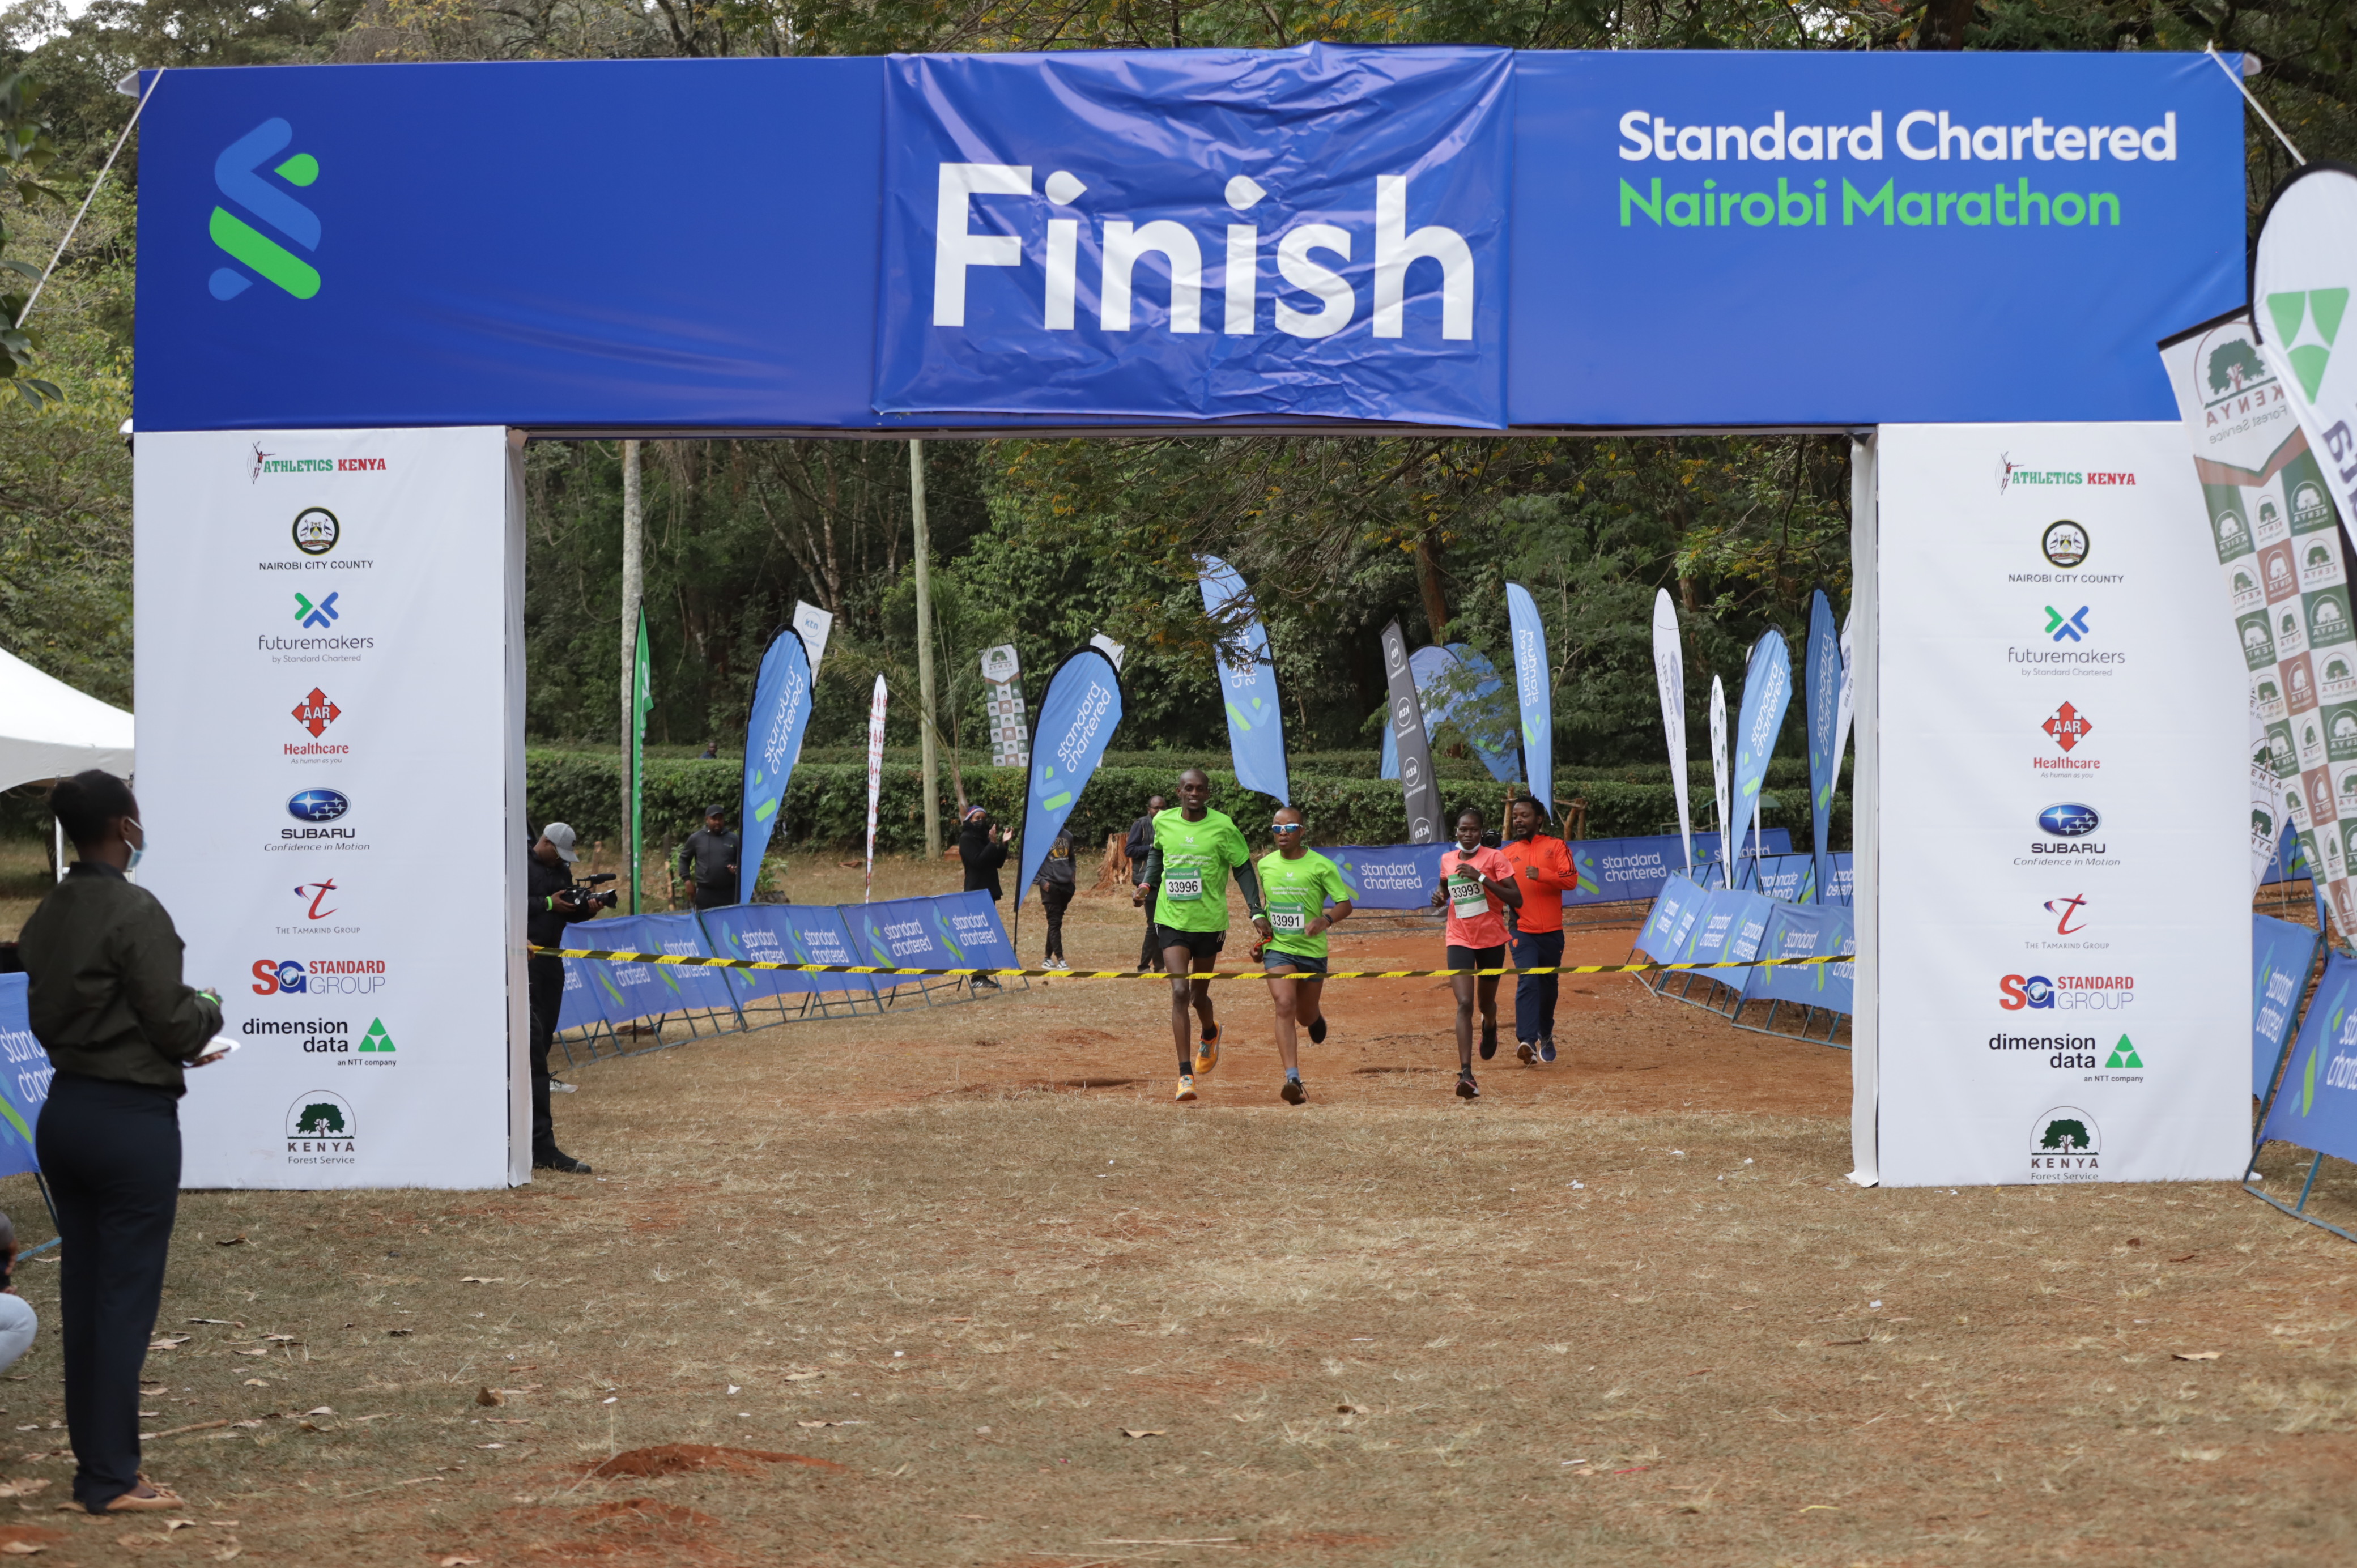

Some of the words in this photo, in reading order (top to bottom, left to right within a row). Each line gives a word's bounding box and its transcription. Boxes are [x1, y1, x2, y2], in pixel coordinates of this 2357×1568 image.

[1619, 110, 1883, 161] Standard
[1896, 110, 2177, 161] Chartered
[1620, 177, 1827, 227] Nairobi
[1843, 177, 2120, 226] Marathon
[933, 162, 1474, 340] Finish
[263, 459, 333, 472] ATHLETICS
[338, 458, 386, 471] KENYA
[2012, 472, 2083, 485] ATHLETICS
[2087, 473, 2136, 485] KENYA
[259, 562, 302, 570] NAIROBI
[305, 561, 327, 570] CITY
[331, 561, 374, 569] COUNTY
[2055, 574, 2078, 583] CITY
[2081, 575, 2124, 583] COUNTY
[805, 619, 819, 630] ktn
[259, 635, 374, 650] futuremakers
[272, 655, 282, 664] by
[2008, 647, 2125, 663] futuremakers
[2022, 668, 2031, 677] by
[1818, 632, 1829, 743] standard
[1751, 661, 1779, 747] standard
[1822, 636, 1835, 756] chartered
[303, 706, 330, 719] AAR
[1756, 667, 1785, 757] chartered
[771, 674, 804, 775] chartered
[1057, 681, 1101, 762] standard
[2053, 721, 2081, 734] AAR
[1067, 688, 1112, 773] chartered
[284, 743, 349, 755] Healthcare
[2033, 756, 2100, 769] Healthcare
[281, 828, 355, 839] SUBARU
[2031, 843, 2105, 854] SUBARU
[1602, 852, 1661, 869] standard
[1360, 862, 1416, 876] standard
[1605, 865, 1667, 882] chartered
[1169, 881, 1198, 893] 33996
[1364, 875, 1422, 889] chartered
[1452, 883, 1480, 898] 33993
[952, 911, 989, 930] standard
[1272, 914, 1299, 927] 33991
[1708, 912, 1734, 930] standard
[804, 929, 840, 945] standard
[884, 918, 923, 940] standard
[742, 929, 778, 948] standard
[960, 928, 997, 947] chartered
[1785, 929, 1820, 949] standard
[892, 935, 933, 957] chartered
[812, 945, 849, 964] chartered
[309, 960, 385, 974] STANDARD
[616, 964, 651, 987] chartered
[2058, 977, 2134, 990] STANDARD
[309, 976, 385, 994] GROUP
[2058, 992, 2134, 1010] GROUP
[242, 1018, 348, 1034] dimension
[303, 1036, 348, 1053] data
[1989, 1034, 2095, 1050] dimension
[2050, 1053, 2095, 1068] data
[288, 1142, 355, 1152] KENYA
[2031, 1158, 2099, 1168] KENYA
